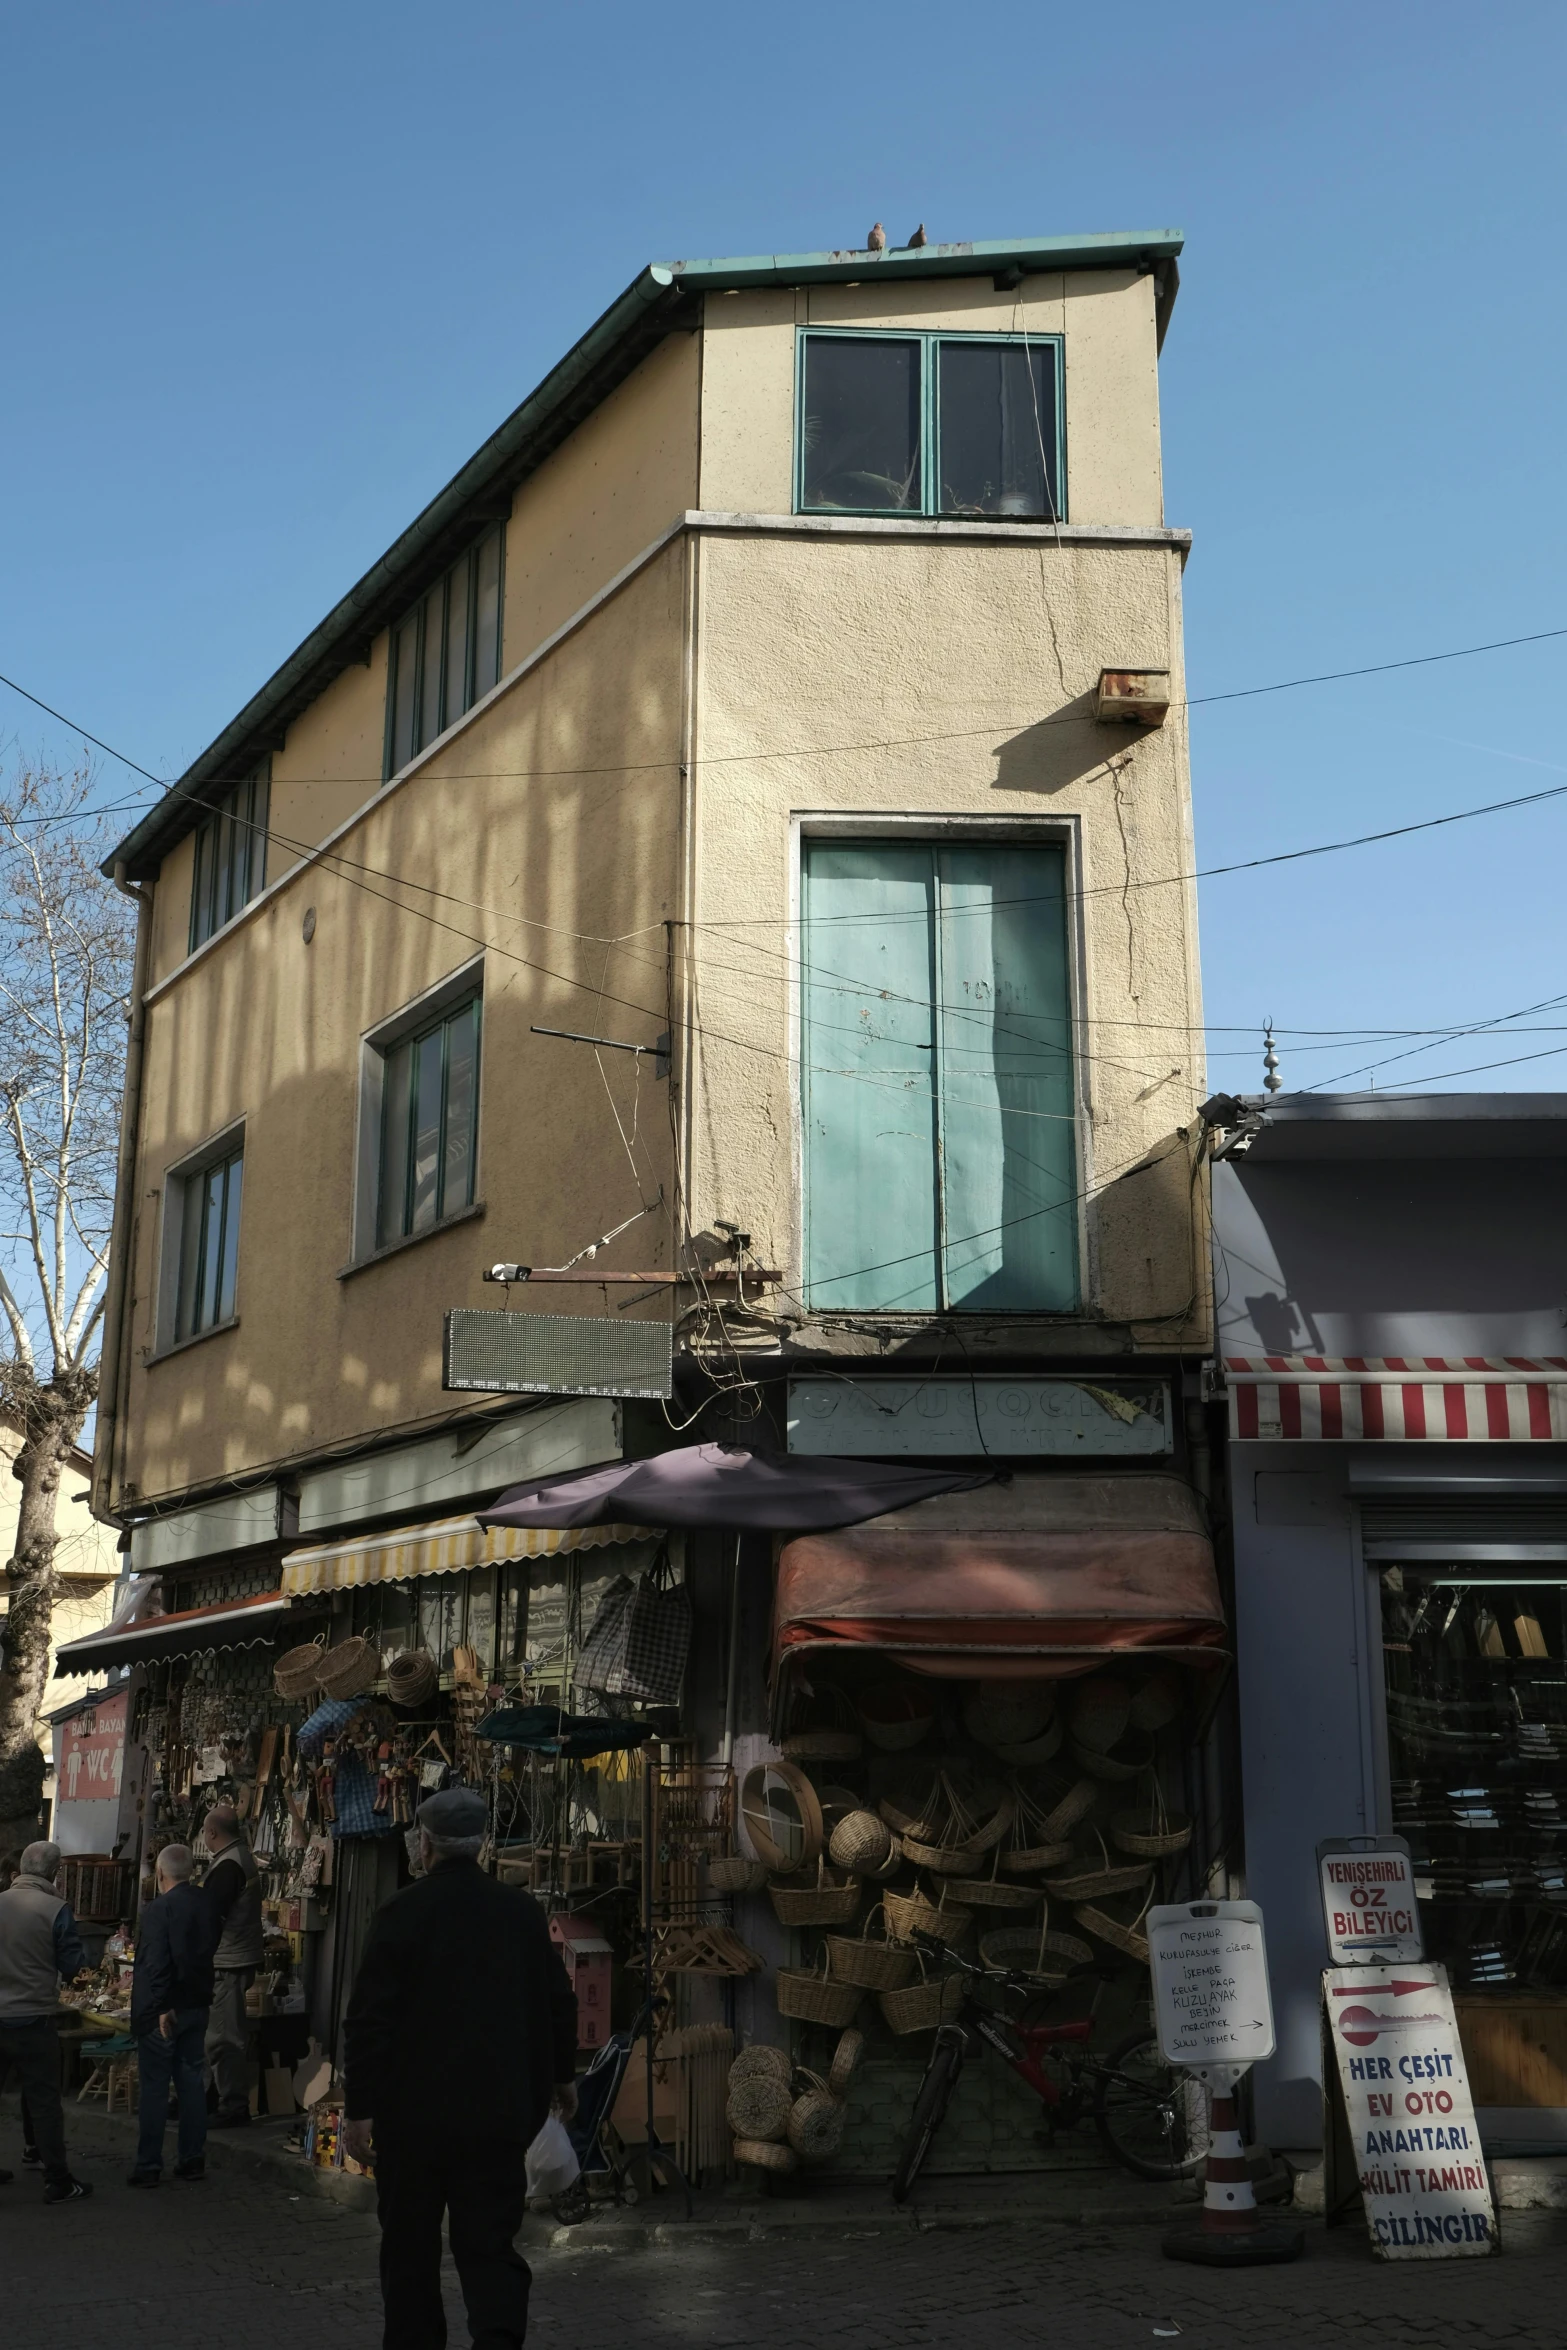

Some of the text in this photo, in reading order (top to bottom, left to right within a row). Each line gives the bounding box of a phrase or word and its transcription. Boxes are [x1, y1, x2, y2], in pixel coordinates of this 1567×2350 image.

[86, 1747, 110, 1782] WC
[1350, 1885, 1388, 1908] ÖZ
[1180, 1928, 1223, 1943] MEŞHUR
[1333, 1909, 1414, 1936] BİLEYİCİ
[1171, 1984, 1199, 1996] KELLE
[1173, 1989, 1238, 2009] KUZU AYAK
[1172, 2033, 1239, 2050] SULU YEMEK
[1348, 2047, 1454, 2085] HER ÇEŞİT
[1366, 2089, 1454, 2117] EV OTO
[1365, 2126, 1469, 2155] ANAHTARI
[1363, 2158, 1485, 2195] KİLİT TAMİRİ
